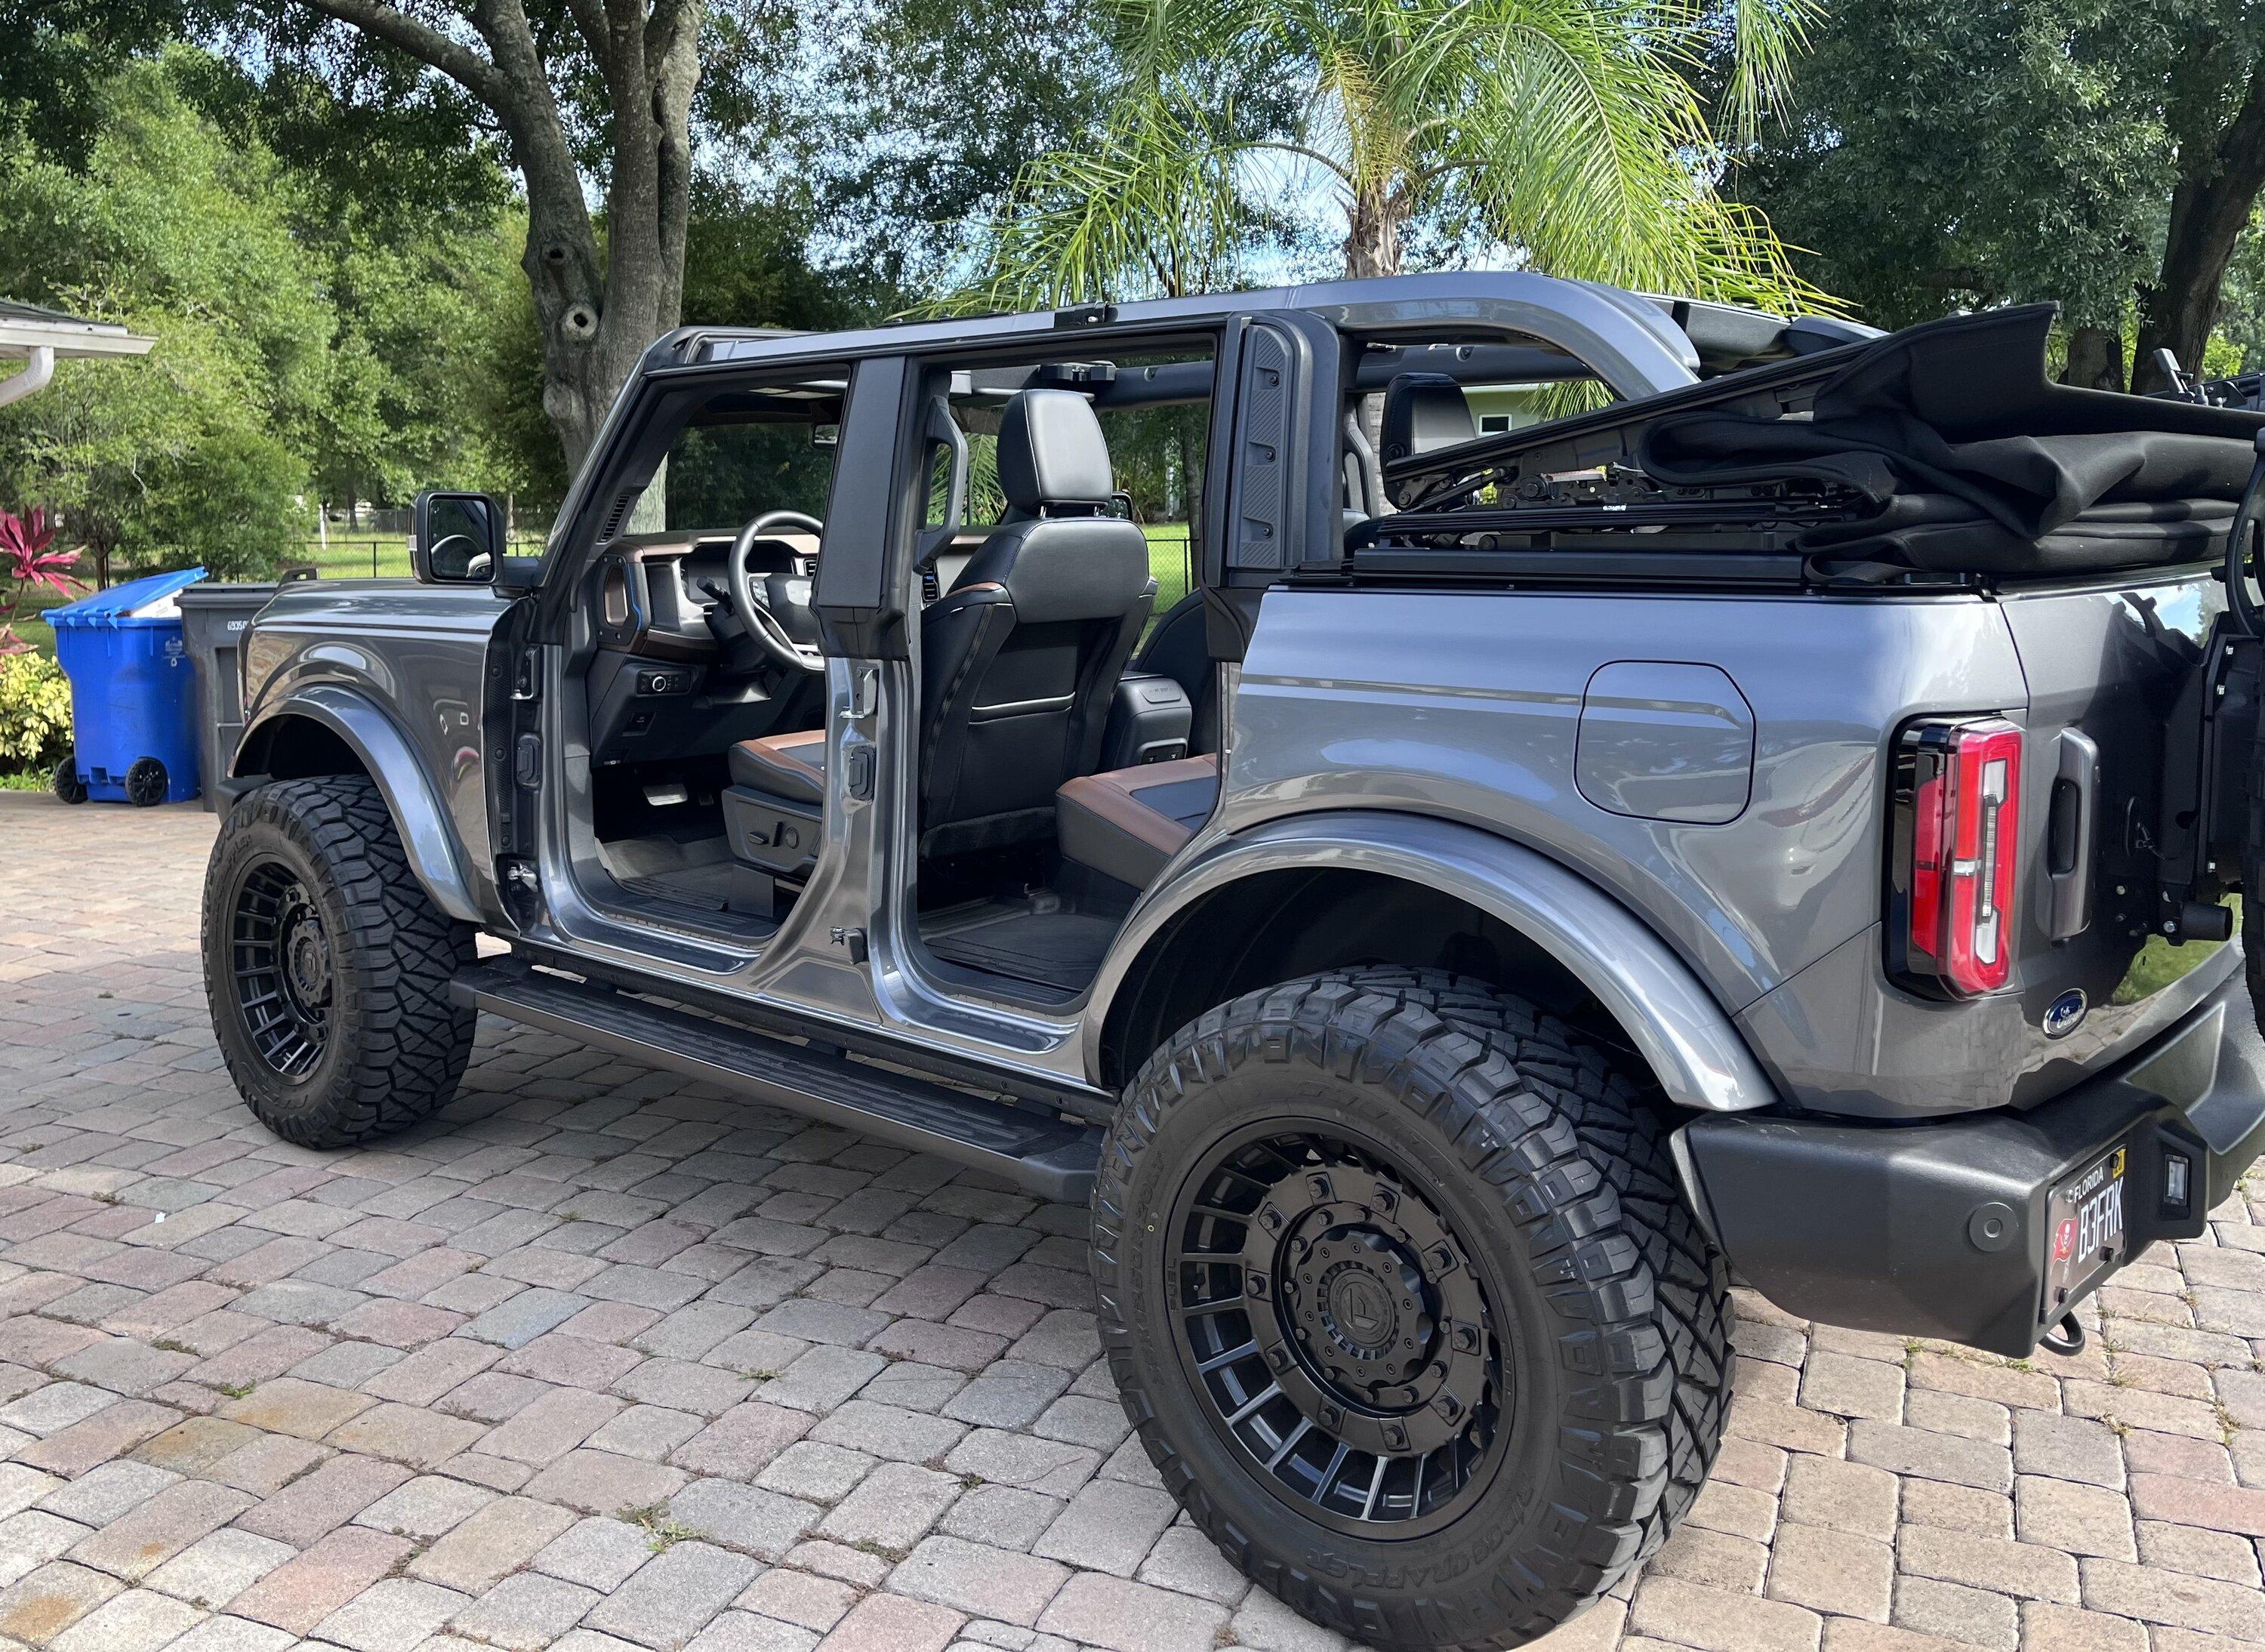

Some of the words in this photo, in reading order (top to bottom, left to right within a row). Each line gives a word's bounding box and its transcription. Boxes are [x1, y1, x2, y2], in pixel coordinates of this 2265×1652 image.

[2073, 1166, 2105, 1204] FLORIDA
[2078, 1176, 2124, 1264] B3FRK
[1167, 1257, 1179, 1313] FUEL
